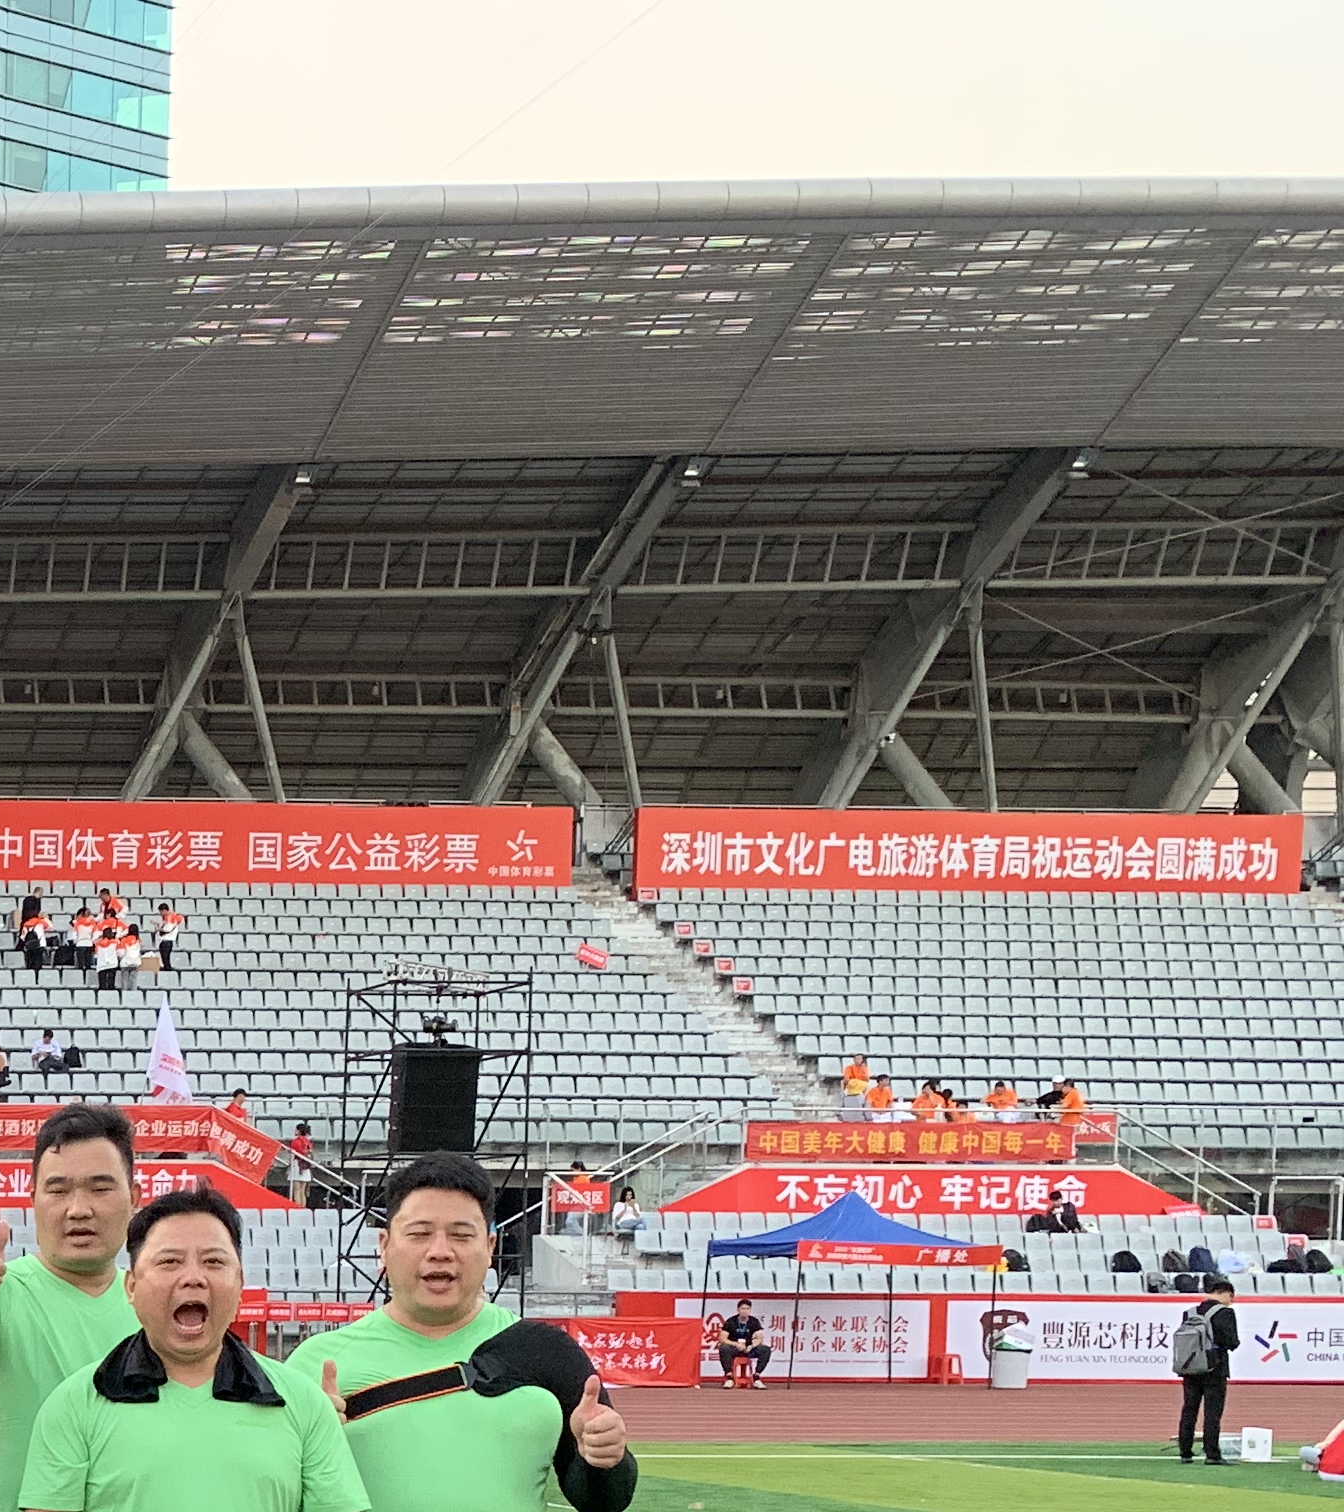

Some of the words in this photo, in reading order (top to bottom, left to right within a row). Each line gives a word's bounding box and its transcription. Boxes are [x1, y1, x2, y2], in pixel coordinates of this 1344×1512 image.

[248, 831, 480, 874] 国家公益彩票
[660, 831, 1279, 882] 深圳市文化广电旅游体育局祝运动会圆满成功
[488, 865, 555, 878] 中国体育彩票
[758, 1130, 907, 1154] 中国美年大健康
[918, 1130, 1066, 1155] 健康中国每一年
[776, 1174, 924, 1211] 不忘初心
[939, 1175, 1087, 1211] 牢记使命
[916, 1248, 969, 1264] 广播处
[761, 1314, 910, 1334] 圳市企业联合会
[761, 1335, 909, 1354] 圳市企业家协会
[1040, 1321, 1171, 1350] 豐源芯科技
[1306, 1327, 1344, 1349] 中国
[1040, 1354, 1063, 1363] FENG
[1065, 1354, 1090, 1363] YUAN
[1092, 1354, 1107, 1363] XIN
[1109, 1354, 1169, 1364] TECHNOLOGY
[1306, 1352, 1340, 1362] CHINA
